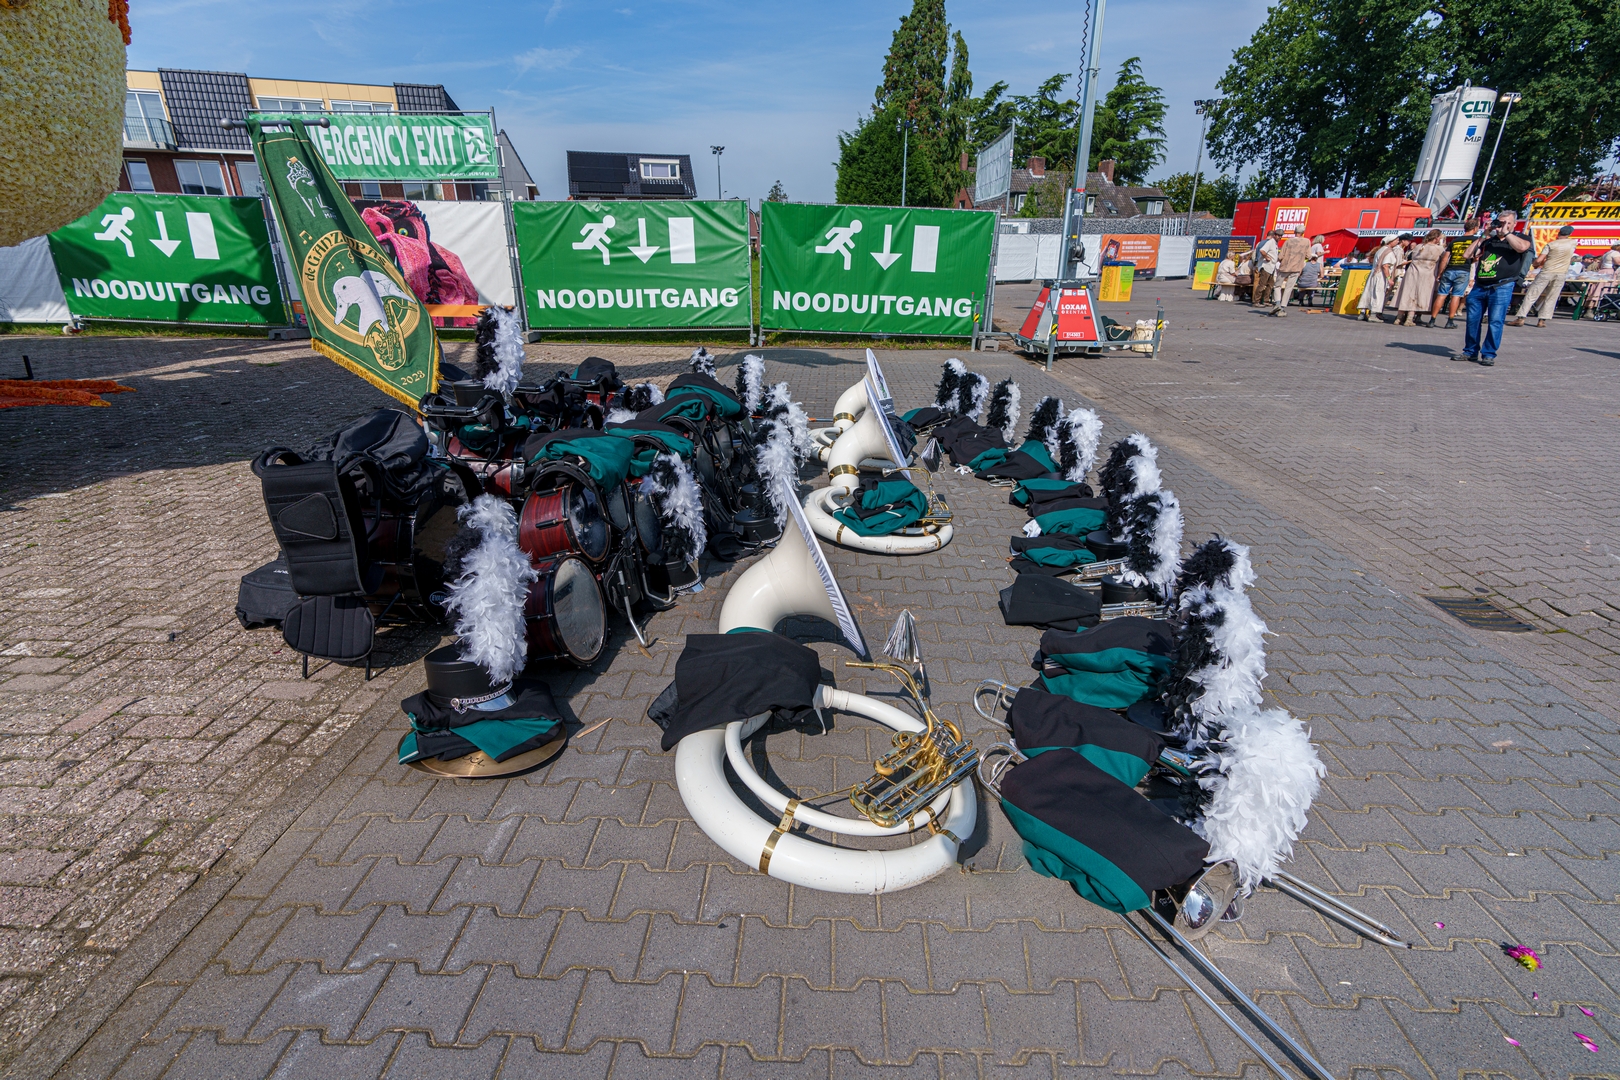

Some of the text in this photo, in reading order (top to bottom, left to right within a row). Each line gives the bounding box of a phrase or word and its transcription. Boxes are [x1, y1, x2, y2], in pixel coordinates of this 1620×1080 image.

[412, 125, 457, 166] EXIT
[1276, 209, 1308, 222] EVENT
[1530, 206, 1620, 218] FRITES-HA
[1275, 222, 1305, 231] CATERI
[1576, 238, 1617, 246] -CATERING.N
[305, 268, 316, 281] de
[72, 277, 270, 305] NOODUITGANG
[537, 288, 738, 309] NOODUITGANG
[773, 290, 972, 317] NOODUITGANG
[400, 370, 426, 386] 2023
[432, 594, 447, 602] EVAN
